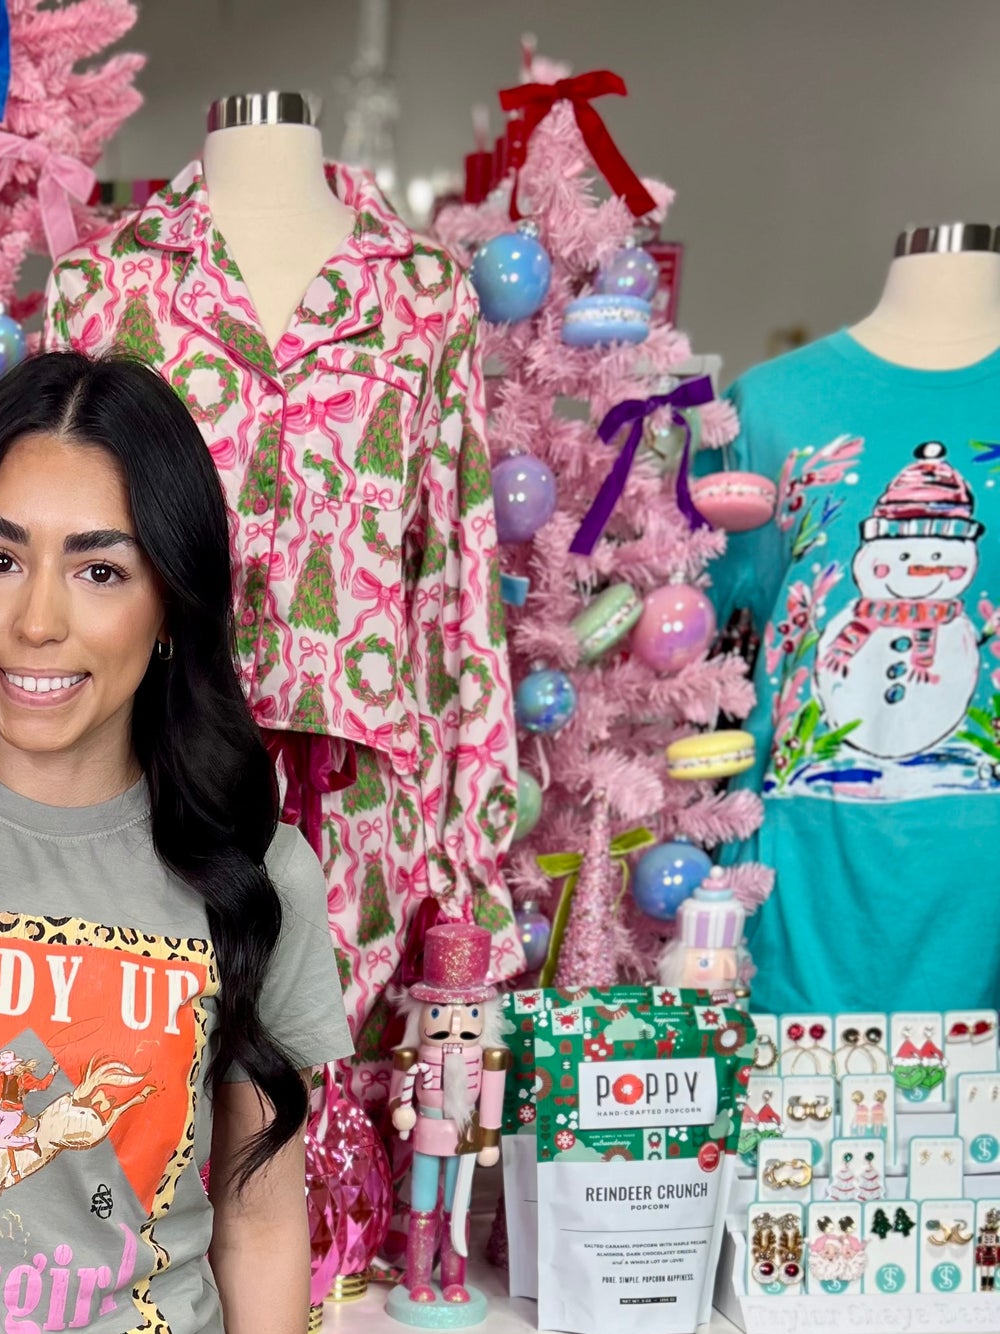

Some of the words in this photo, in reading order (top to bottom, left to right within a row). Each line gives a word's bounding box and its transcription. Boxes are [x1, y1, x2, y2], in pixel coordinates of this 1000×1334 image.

[120, 961, 199, 1035] UP
[597, 1109, 662, 1117] HAND-CRAFTED
[585, 1184, 652, 1201] REINDEER
[657, 1182, 708, 1200] CRUNCH
[642, 1275, 666, 1283] POPCORN
